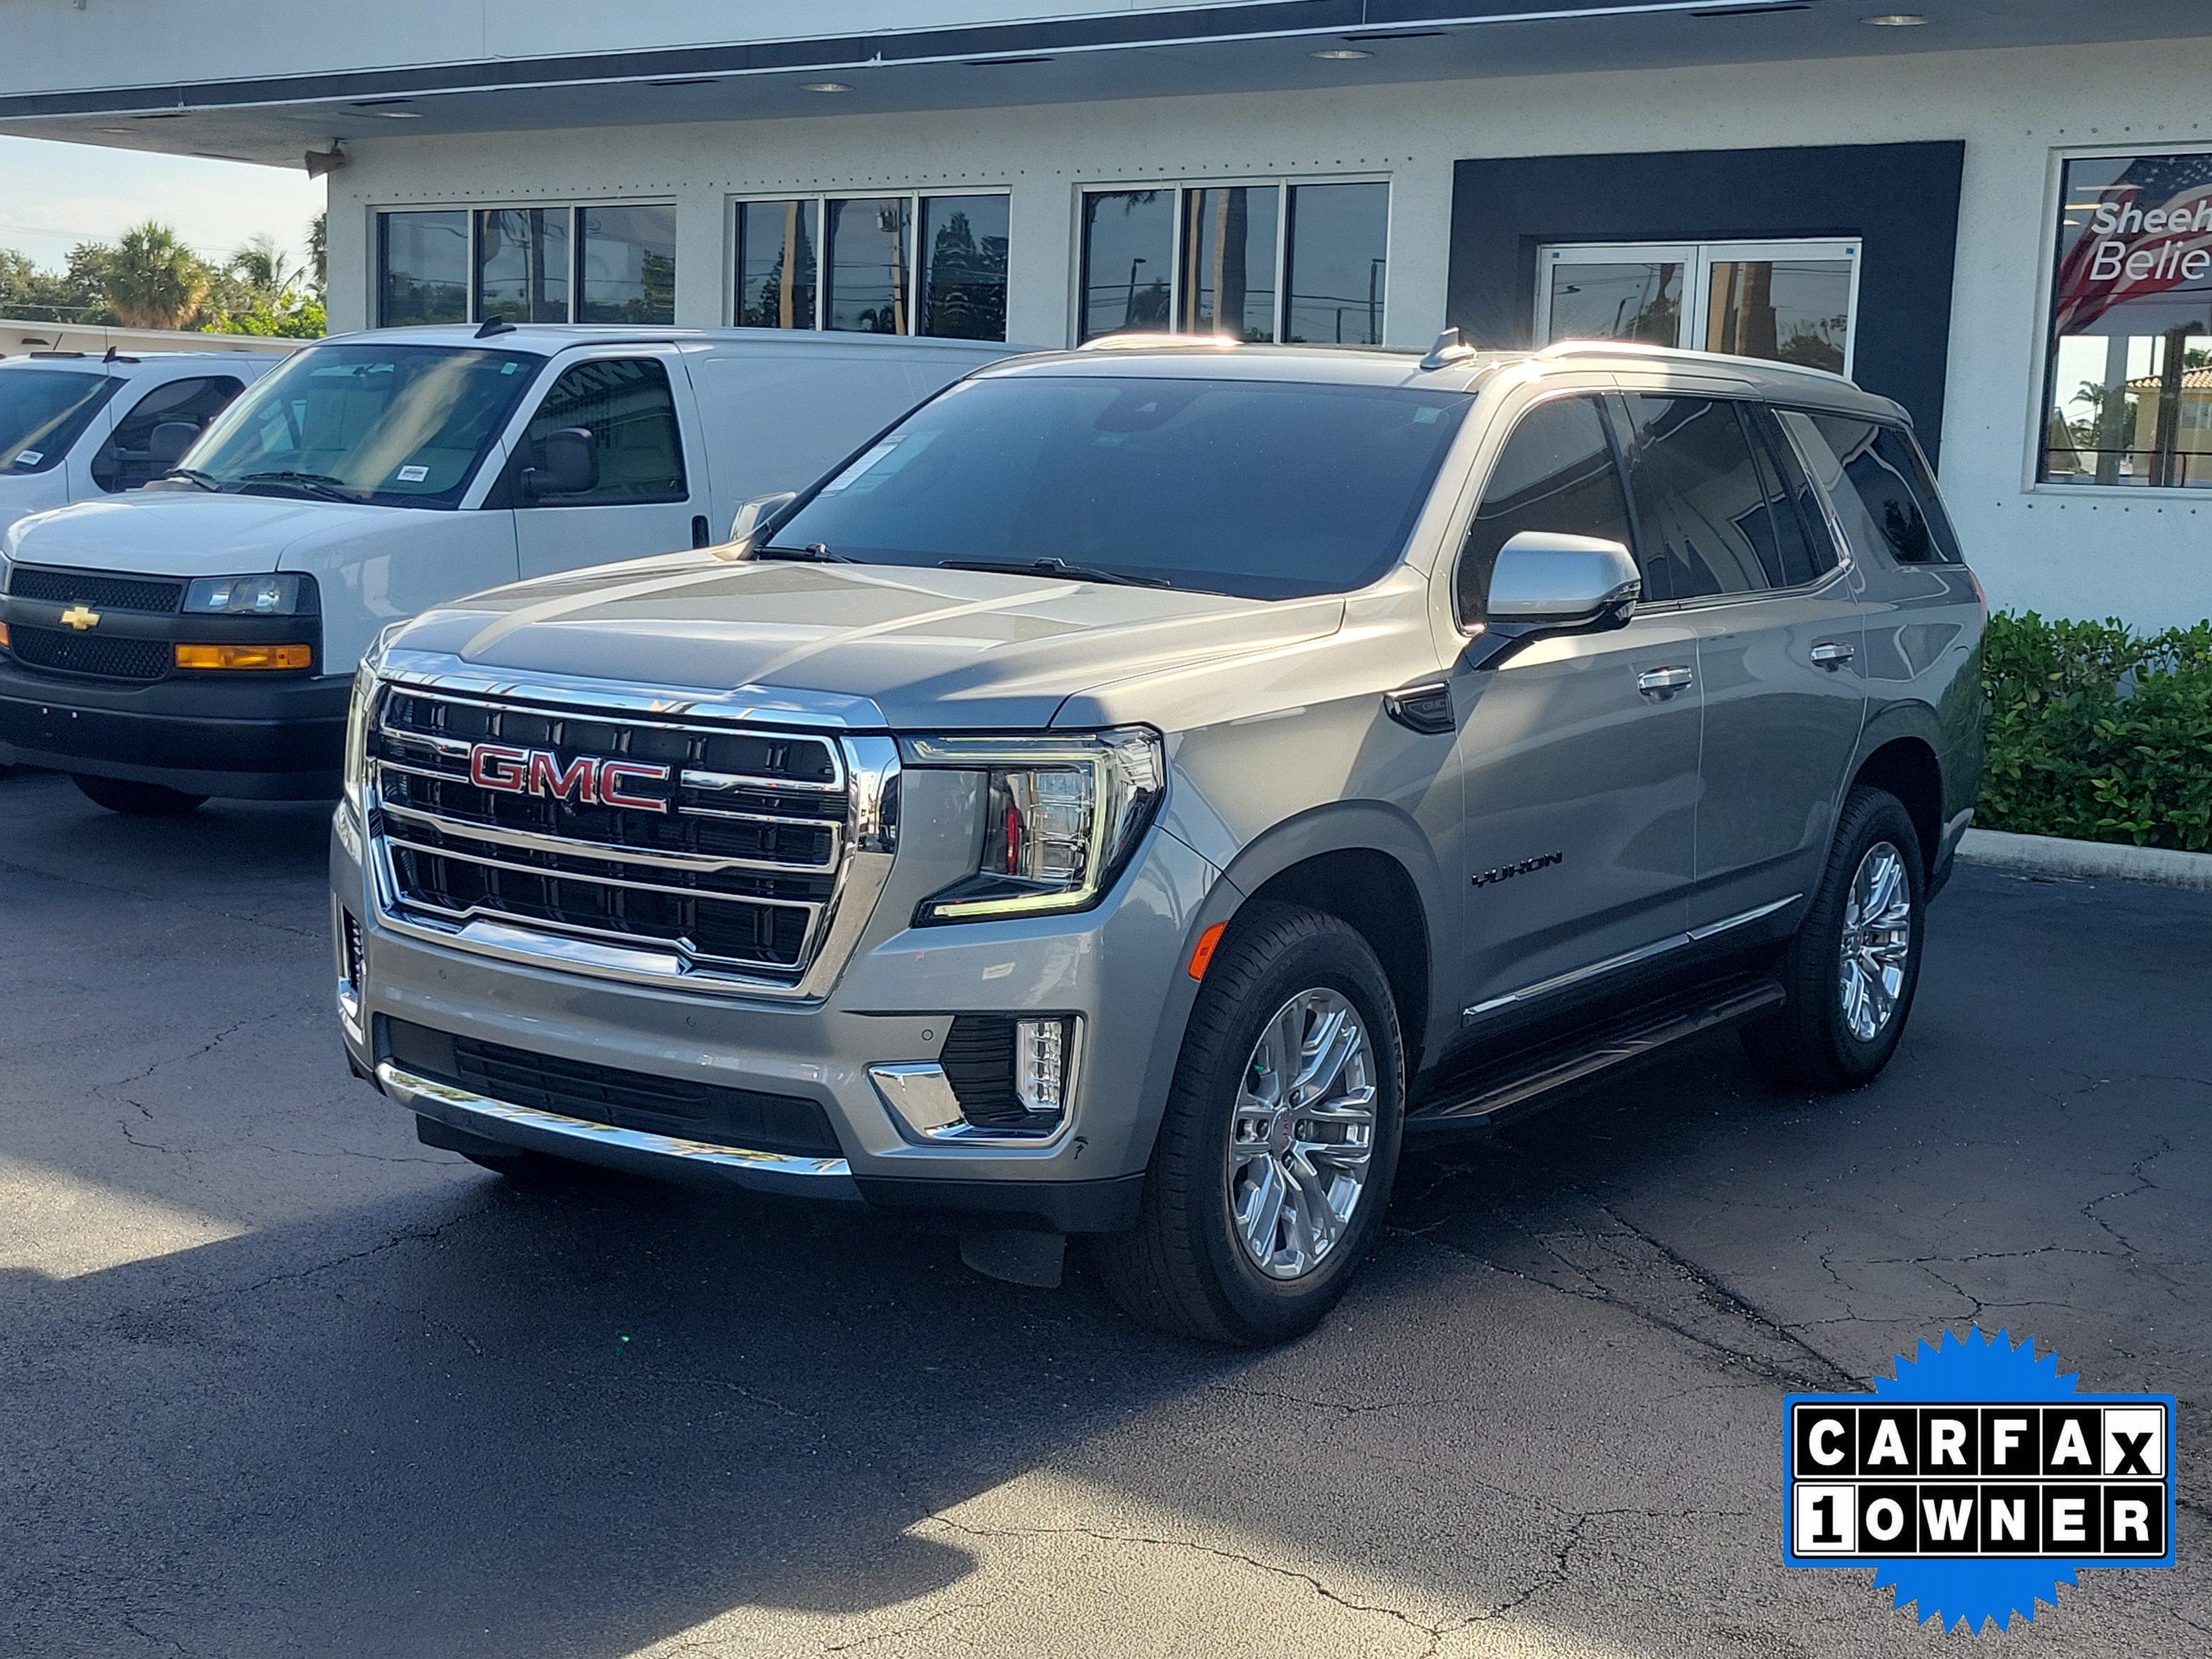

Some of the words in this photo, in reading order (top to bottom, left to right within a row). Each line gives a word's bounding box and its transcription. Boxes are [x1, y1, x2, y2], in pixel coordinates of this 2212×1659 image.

[2091, 200, 2212, 234] Sheeh
[2089, 240, 2210, 280] Belie
[470, 743, 670, 814] GMC
[1471, 851, 1562, 888] YUKON
